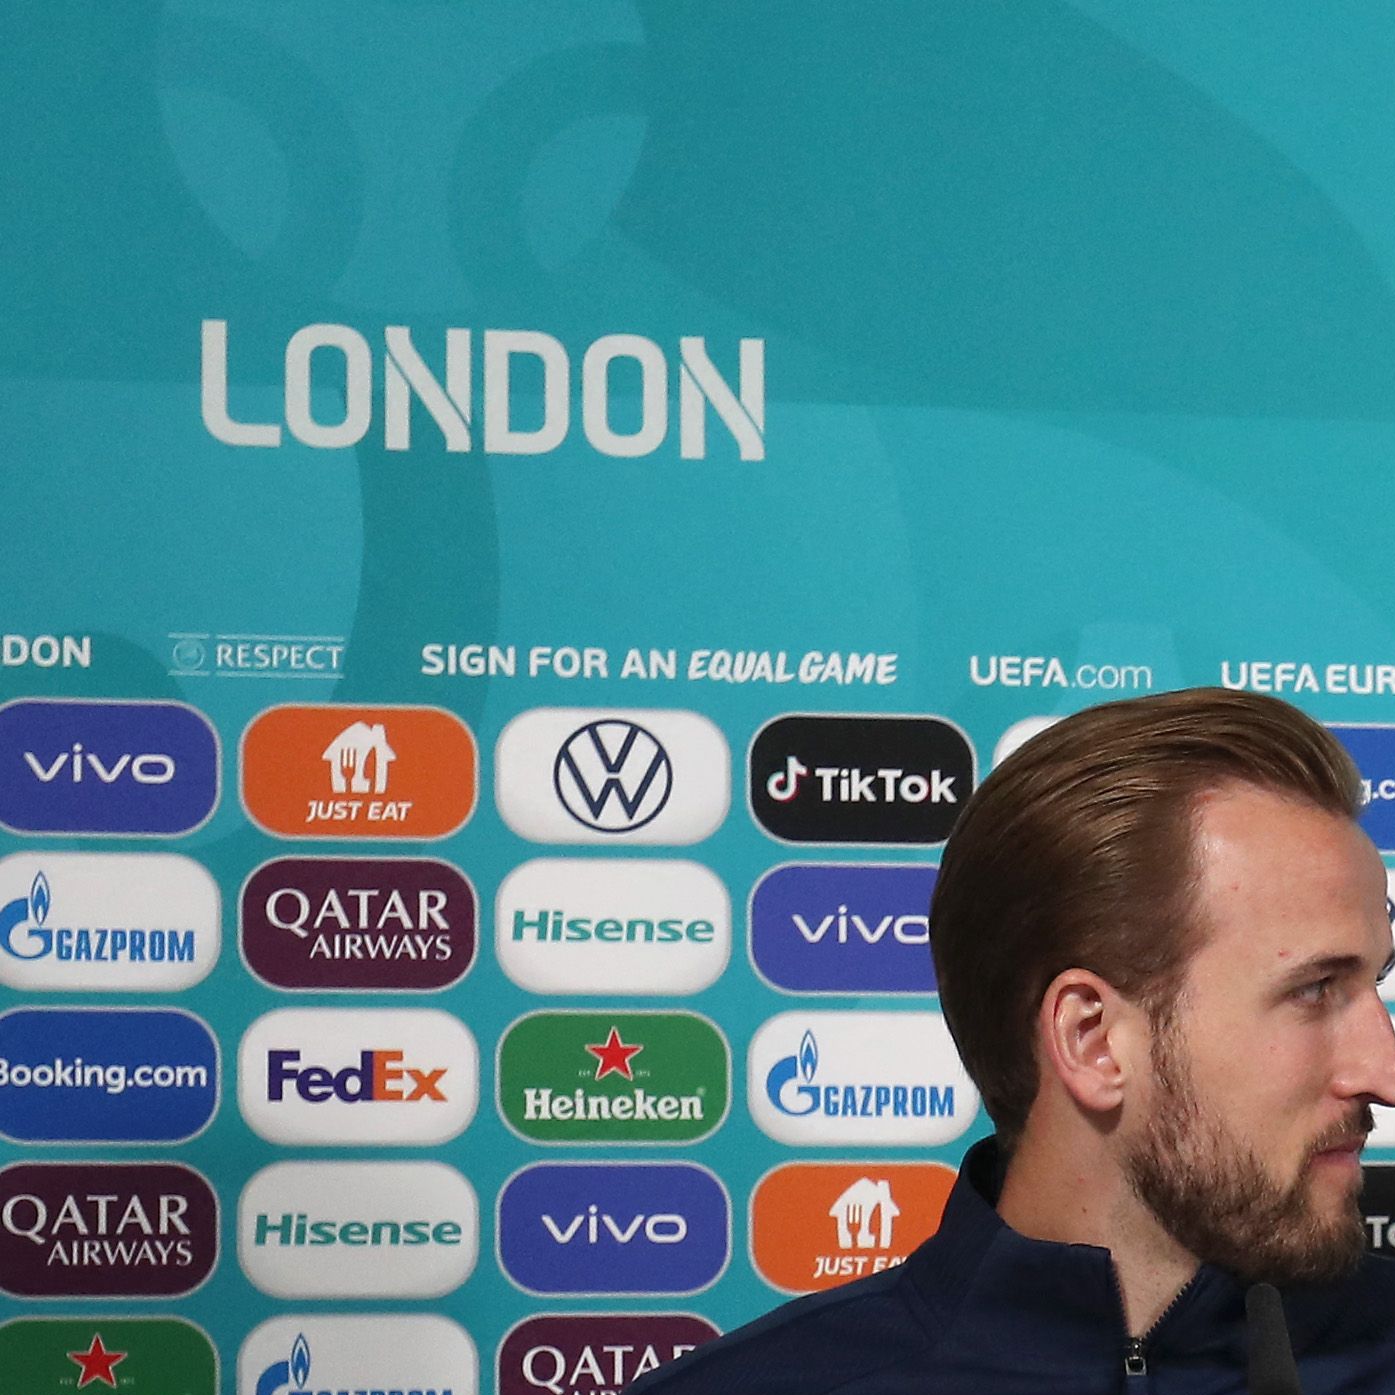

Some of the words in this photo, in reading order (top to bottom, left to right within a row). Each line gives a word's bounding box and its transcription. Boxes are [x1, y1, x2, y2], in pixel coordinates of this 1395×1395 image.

[202, 320, 765, 461] LONDON
[214, 644, 343, 670] RESPECT
[422, 644, 515, 676] SIGN
[530, 647, 608, 678] FOR
[621, 649, 676, 679] AN
[688, 650, 794, 683] EQUAL
[799, 651, 897, 684] GAME
[971, 656, 1151, 689] UEFA.com
[1222, 662, 1319, 693] UEFA
[25, 743, 175, 783] vivo
[815, 768, 956, 803] TikTok
[306, 801, 362, 822] JUST
[368, 802, 412, 821] EAT
[266, 889, 449, 934] QATAR
[512, 910, 714, 943] Hisense
[57, 929, 194, 962] GAZPROM
[310, 934, 451, 960] AIRWAYS
[268, 1050, 446, 1103] FedEx
[524, 1088, 703, 1119] Heineken
[824, 1082, 954, 1117] GAZPROM
[3, 1195, 190, 1245] QATAR
[254, 1214, 461, 1246] Hisense
[542, 1205, 687, 1243] vivo
[47, 1240, 192, 1265] AIRWAYS
[814, 1256, 869, 1278] JUST
